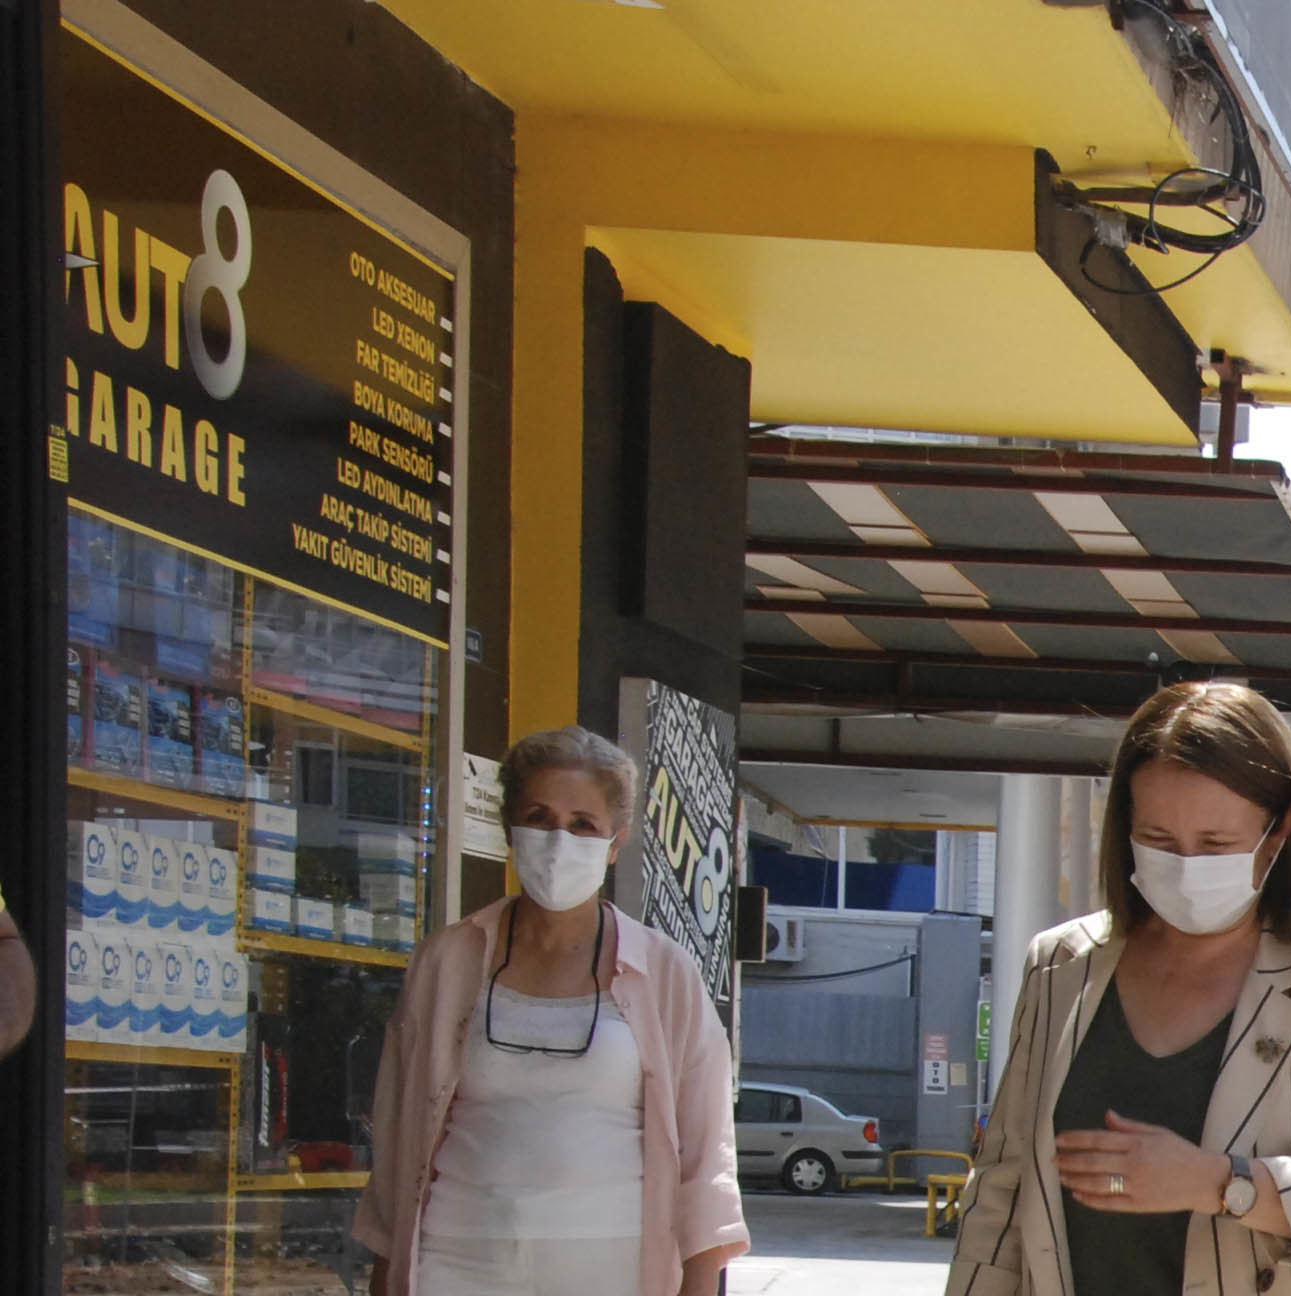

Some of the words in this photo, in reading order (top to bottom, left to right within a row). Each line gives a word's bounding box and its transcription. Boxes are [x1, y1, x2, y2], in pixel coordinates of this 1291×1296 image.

[350, 251, 375, 286] OTO
[377, 269, 436, 325] AKSESUAR
[357, 339, 380, 374] FAR
[372, 306, 395, 339] LED
[397, 320, 435, 365] XENON
[354, 379, 385, 419] BOYA
[387, 397, 434, 445] KORUMA
[349, 420, 380, 458] PARK
[382, 436, 434, 485] SENSÖRÜ
[337, 456, 361, 489] LED
[363, 469, 432, 524] AYDINLATMA
[320, 493, 354, 533] ARAÇ
[356, 507, 389, 543] TAKİP
[391, 521, 432, 564] SİSTEMİ
[292, 522, 329, 561] YAKIT
[330, 538, 389, 587] GÜVENLİK
[390, 562, 432, 604] SİSTEMİ
[665, 708, 715, 828] GARAGE
